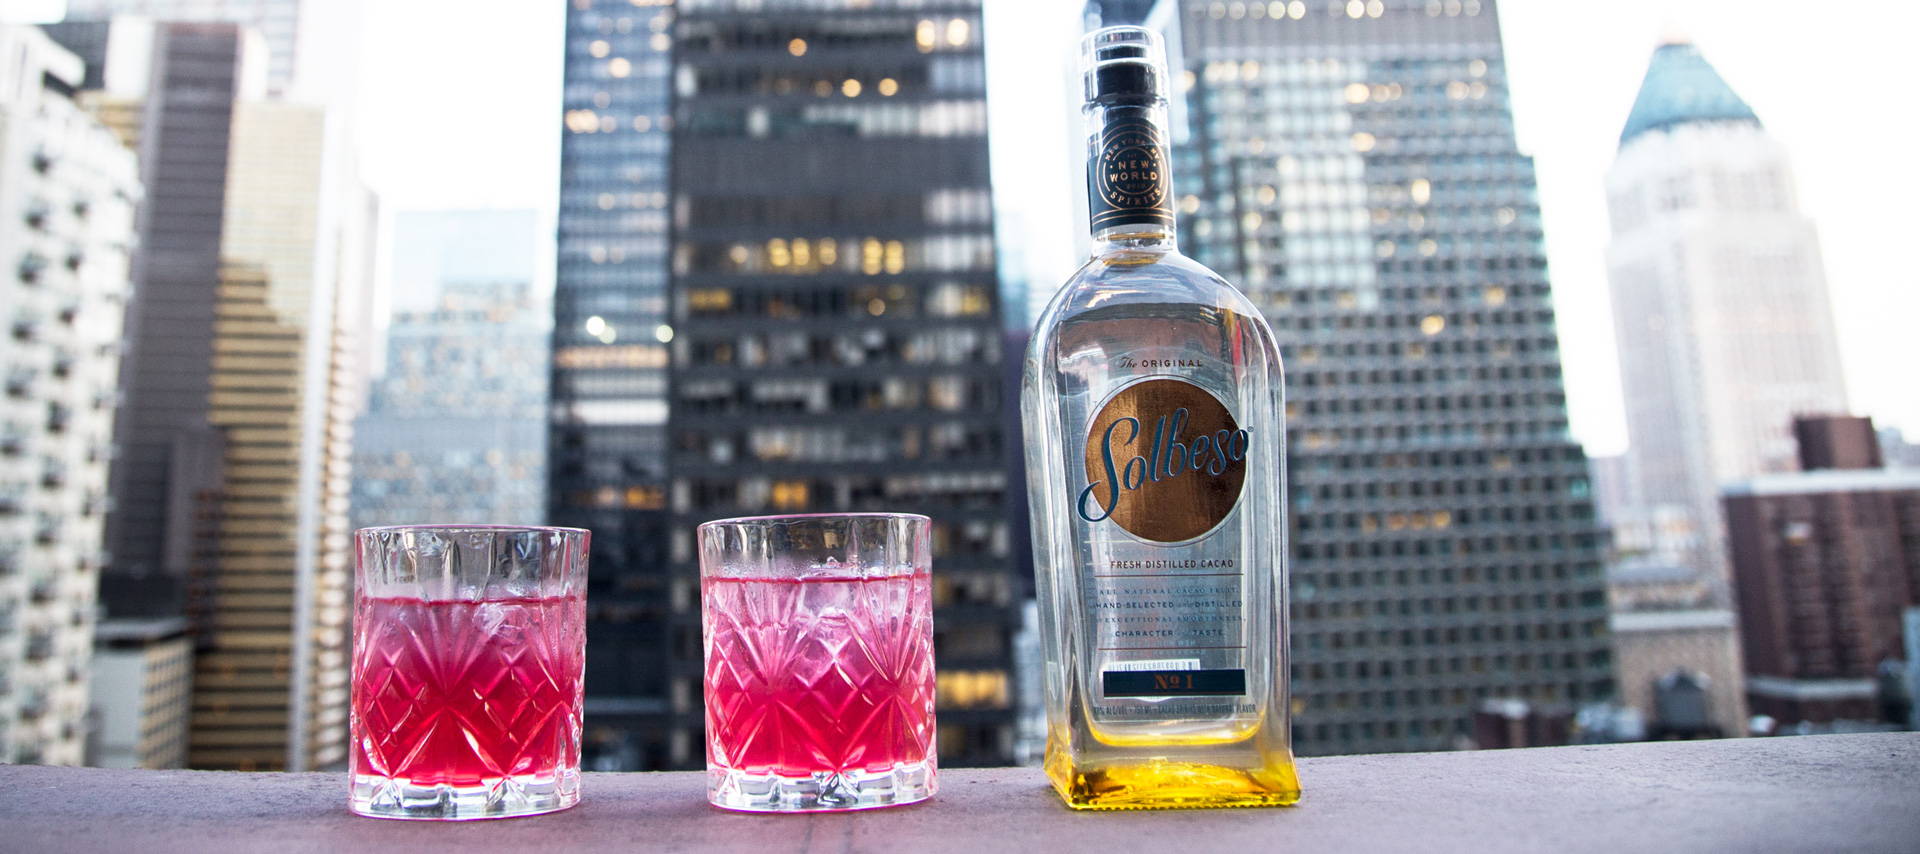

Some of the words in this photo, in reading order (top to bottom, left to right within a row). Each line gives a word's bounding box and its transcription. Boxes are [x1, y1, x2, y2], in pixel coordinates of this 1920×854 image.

[1118, 160, 1149, 170] NEW
[1110, 171, 1157, 183] WORLD
[1110, 187, 1161, 205] SPIRITS
[1120, 357, 1137, 369] The
[1141, 359, 1203, 368] ORIGINAL
[1077, 407, 1250, 523] Solbeso
[1110, 560, 1142, 570] FRESH
[1145, 560, 1197, 569] DISTILLED
[1201, 559, 1234, 569] CACAO
[1099, 588, 1117, 596] ALL
[1176, 587, 1206, 595] CACAO
[1105, 616, 1173, 624] EXCEPTIONAL
[1192, 629, 1224, 637] TASTE
